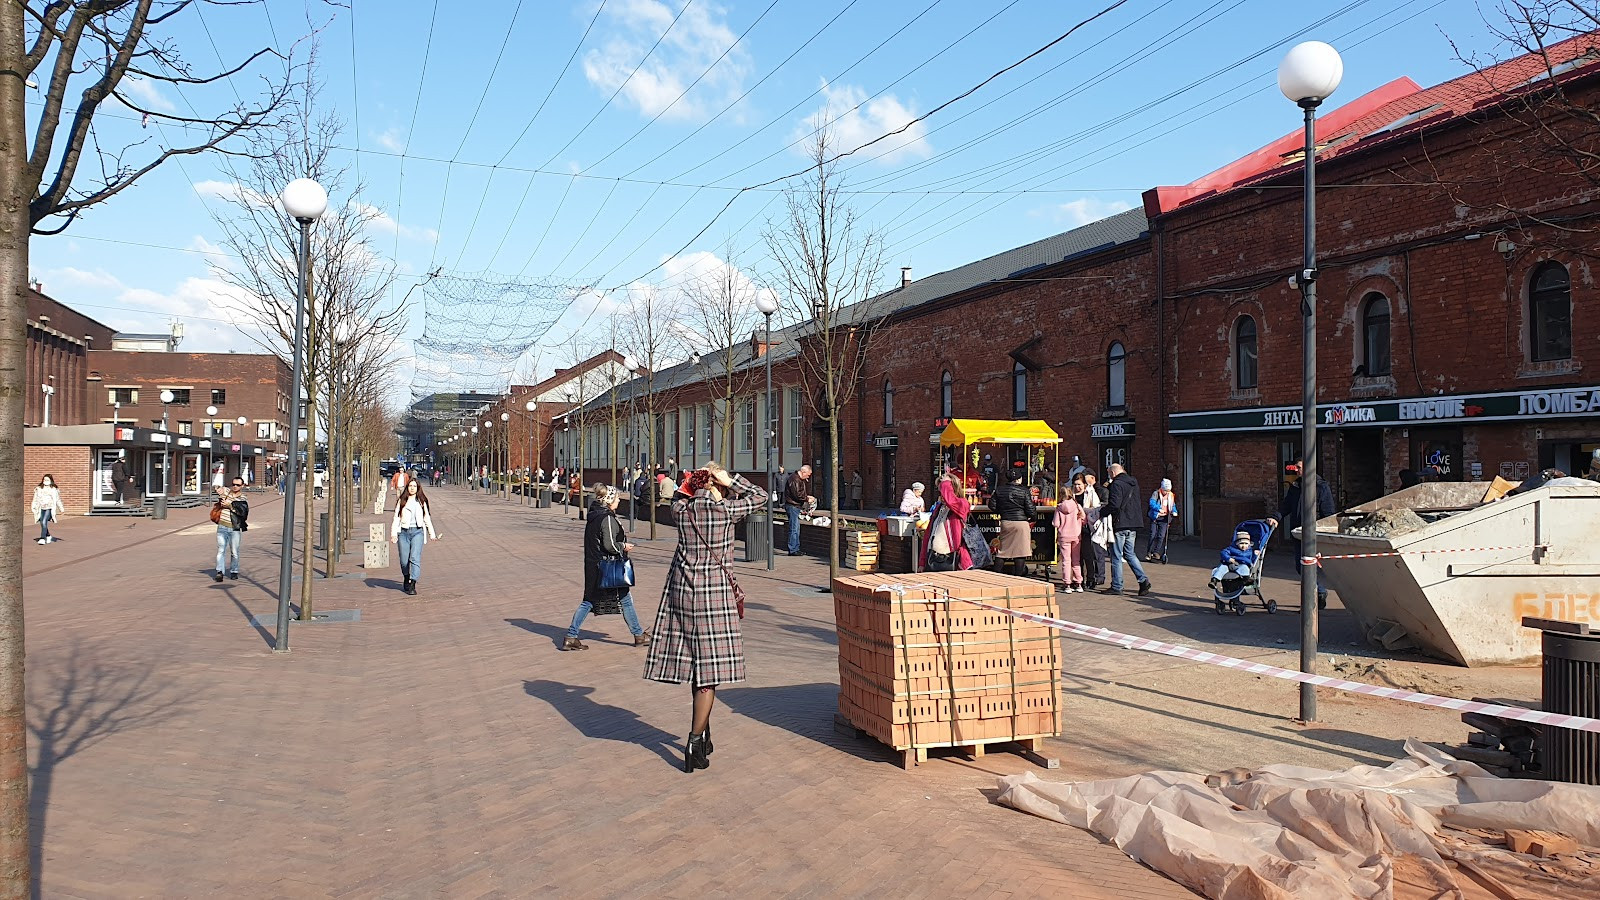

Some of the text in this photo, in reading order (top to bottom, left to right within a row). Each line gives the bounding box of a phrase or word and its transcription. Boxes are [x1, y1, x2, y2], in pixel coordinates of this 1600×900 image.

[1325, 406, 1376, 424] ЯМАЙКА
[1399, 400, 1465, 420] EROCODE
[1091, 425, 1125, 436] ЯНТАРЬ
[1425, 453, 1450, 465] LOVE
